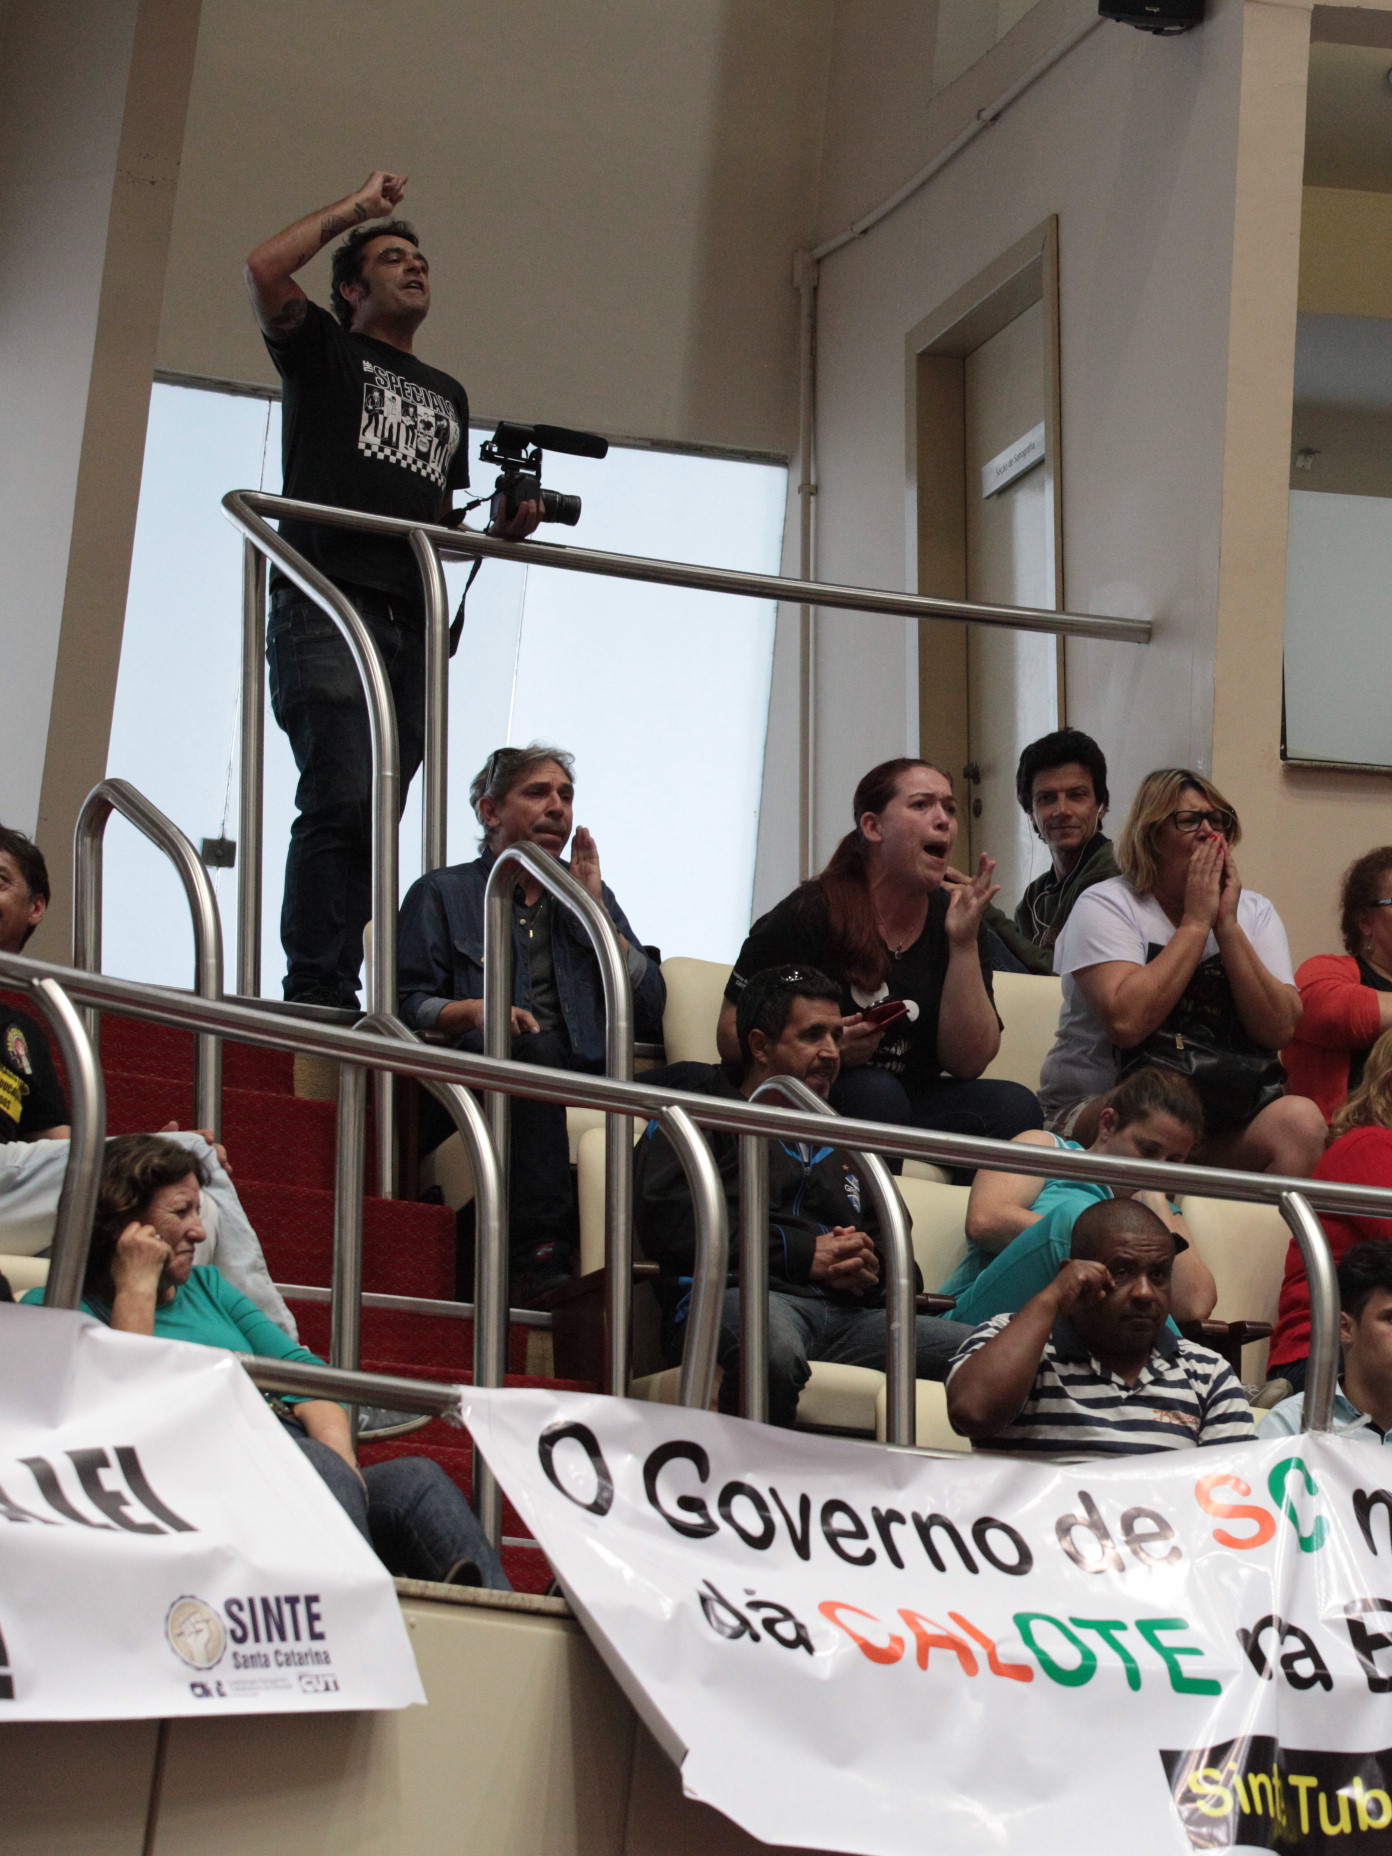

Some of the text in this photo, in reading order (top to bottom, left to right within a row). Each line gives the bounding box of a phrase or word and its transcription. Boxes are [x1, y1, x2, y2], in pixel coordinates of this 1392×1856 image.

[537, 1421, 615, 1517] O
[642, 1440, 1034, 1576] Governo
[1054, 1490, 1183, 1574] de
[1194, 1457, 1331, 1553] SC
[224, 1594, 326, 1645] SINTE
[817, 1600, 1223, 1696] CALOTE
[1236, 1613, 1334, 1692] na
[232, 1648, 332, 1670] Santa Catarina
